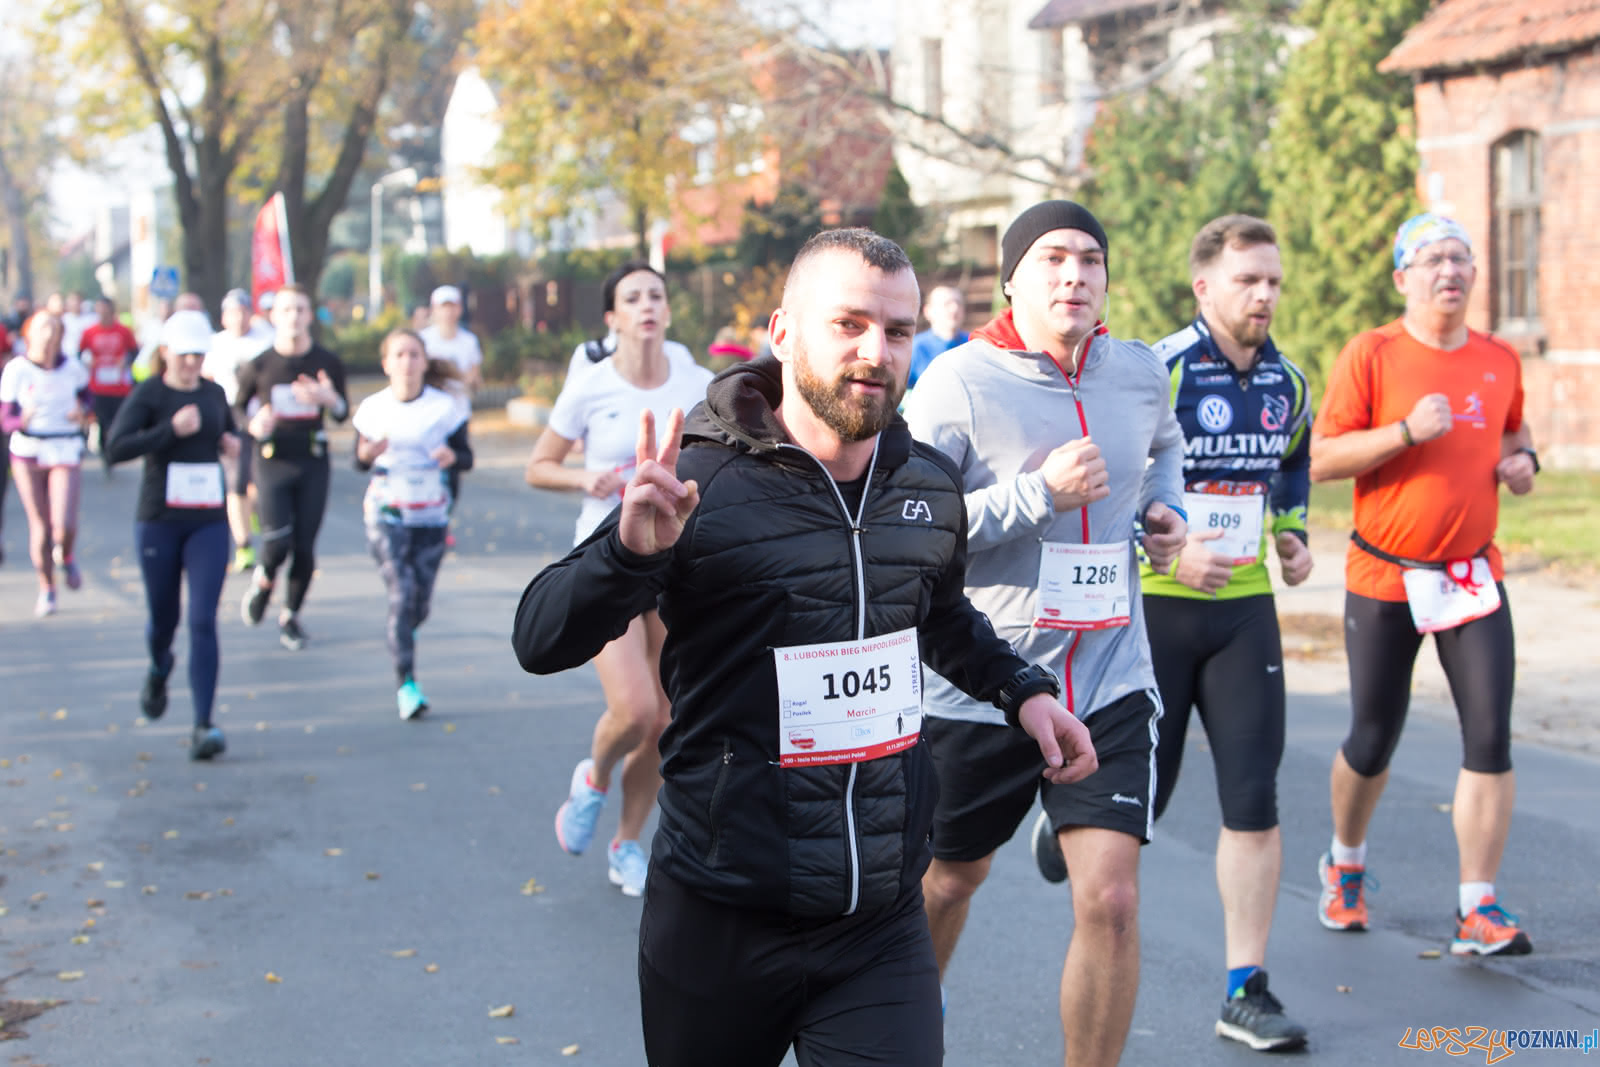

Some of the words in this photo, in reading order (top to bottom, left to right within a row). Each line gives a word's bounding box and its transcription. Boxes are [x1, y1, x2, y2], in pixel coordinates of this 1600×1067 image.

[1208, 512, 1241, 529] 809
[1072, 564, 1117, 585] 1286
[784, 652, 792, 661] 8.
[794, 647, 839, 660] LUBOŃSKI
[841, 646, 860, 656] BIEG
[862, 634, 912, 654] NIEPODLEGŁOŚCI
[822, 664, 892, 700] 1045
[847, 706, 876, 719] Marcin
